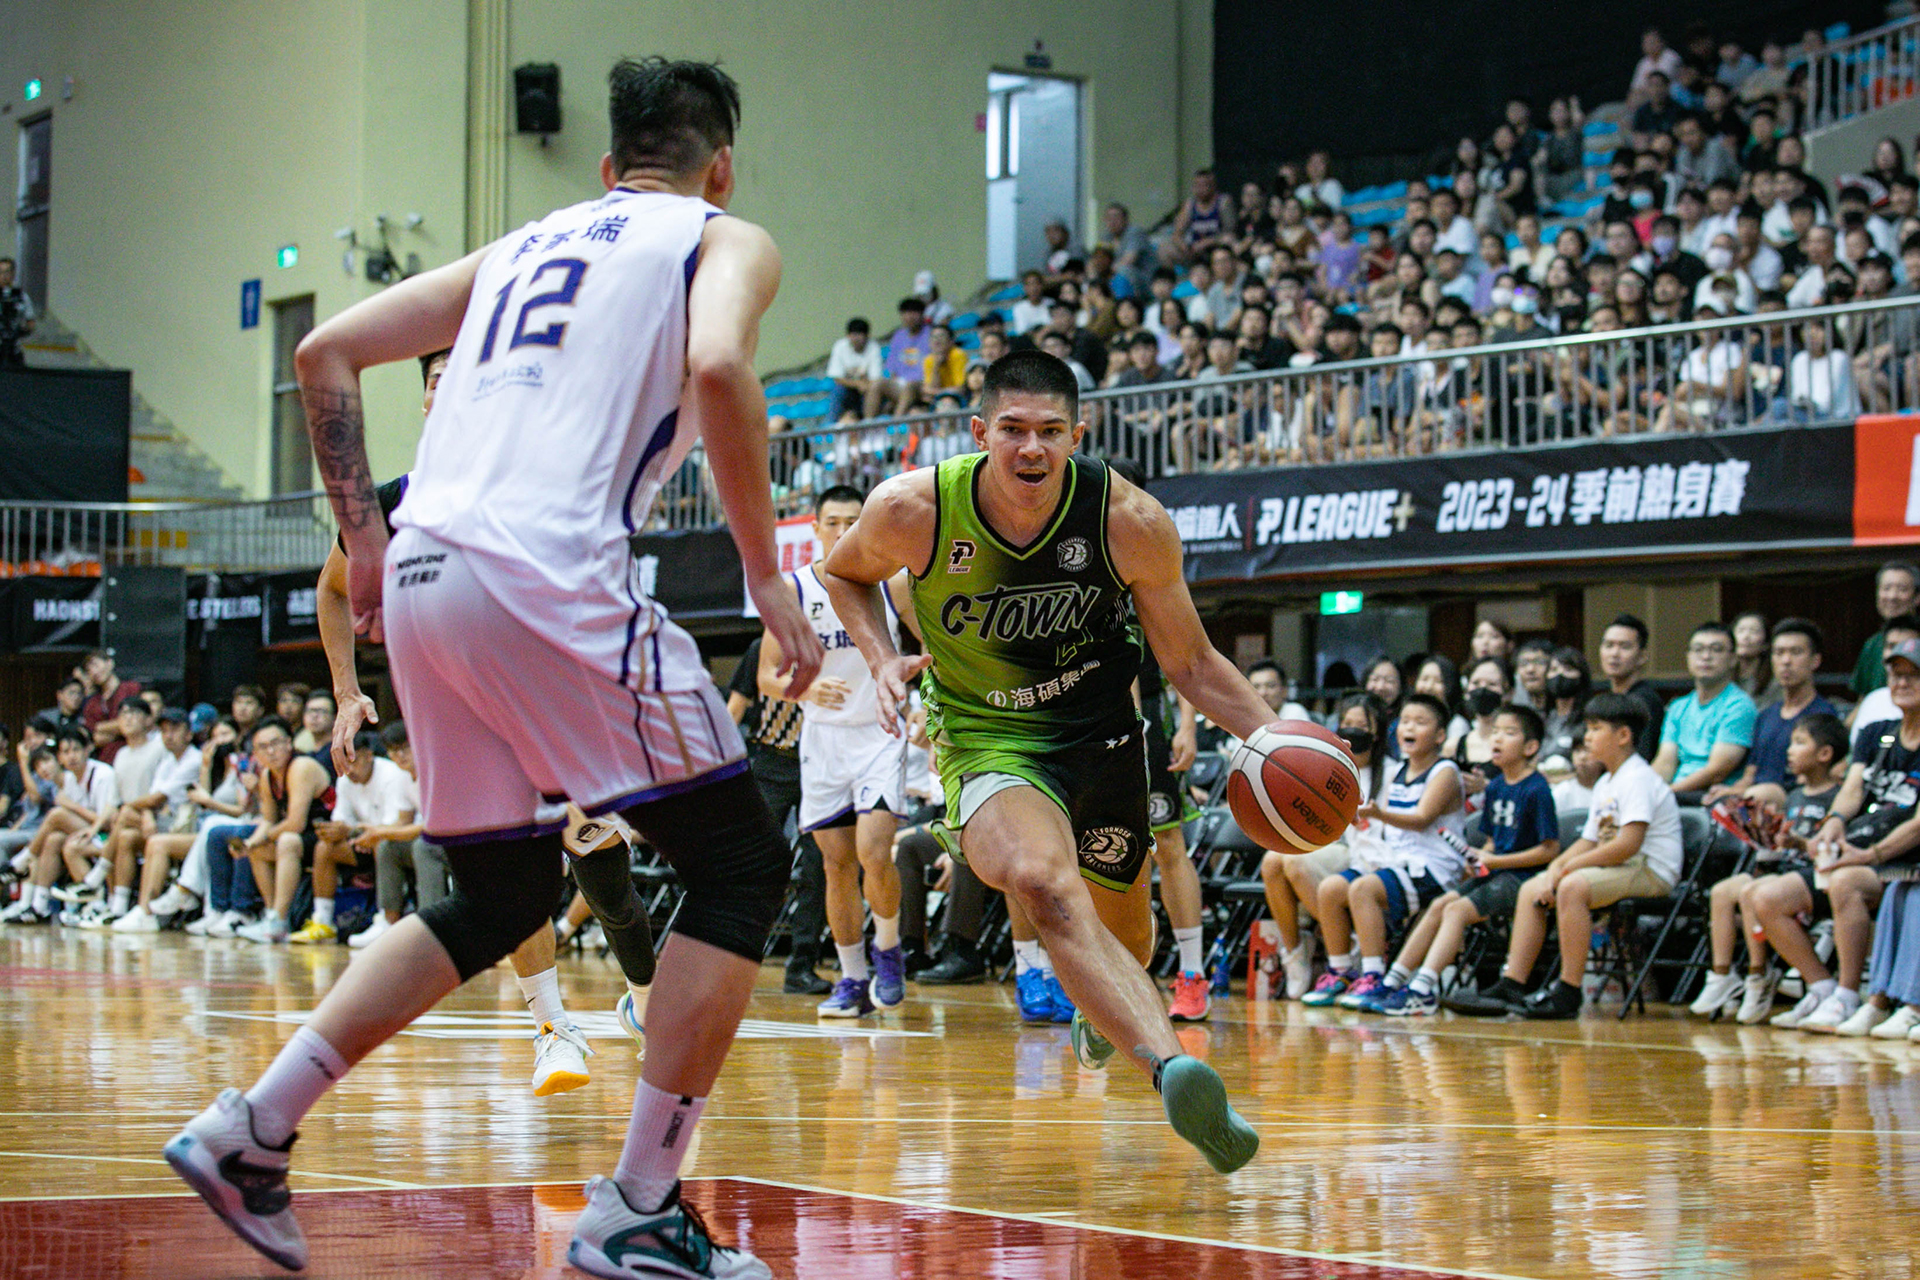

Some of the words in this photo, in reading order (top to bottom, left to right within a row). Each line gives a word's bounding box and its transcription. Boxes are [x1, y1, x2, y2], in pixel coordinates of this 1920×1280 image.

[475, 256, 592, 368] 12
[1436, 473, 1570, 534] 2023-24
[1569, 459, 1751, 526] 季前熱身賽
[940, 581, 1102, 642] C-TOWN
[1292, 796, 1334, 837] molten
[1325, 776, 1348, 803] FIBA
